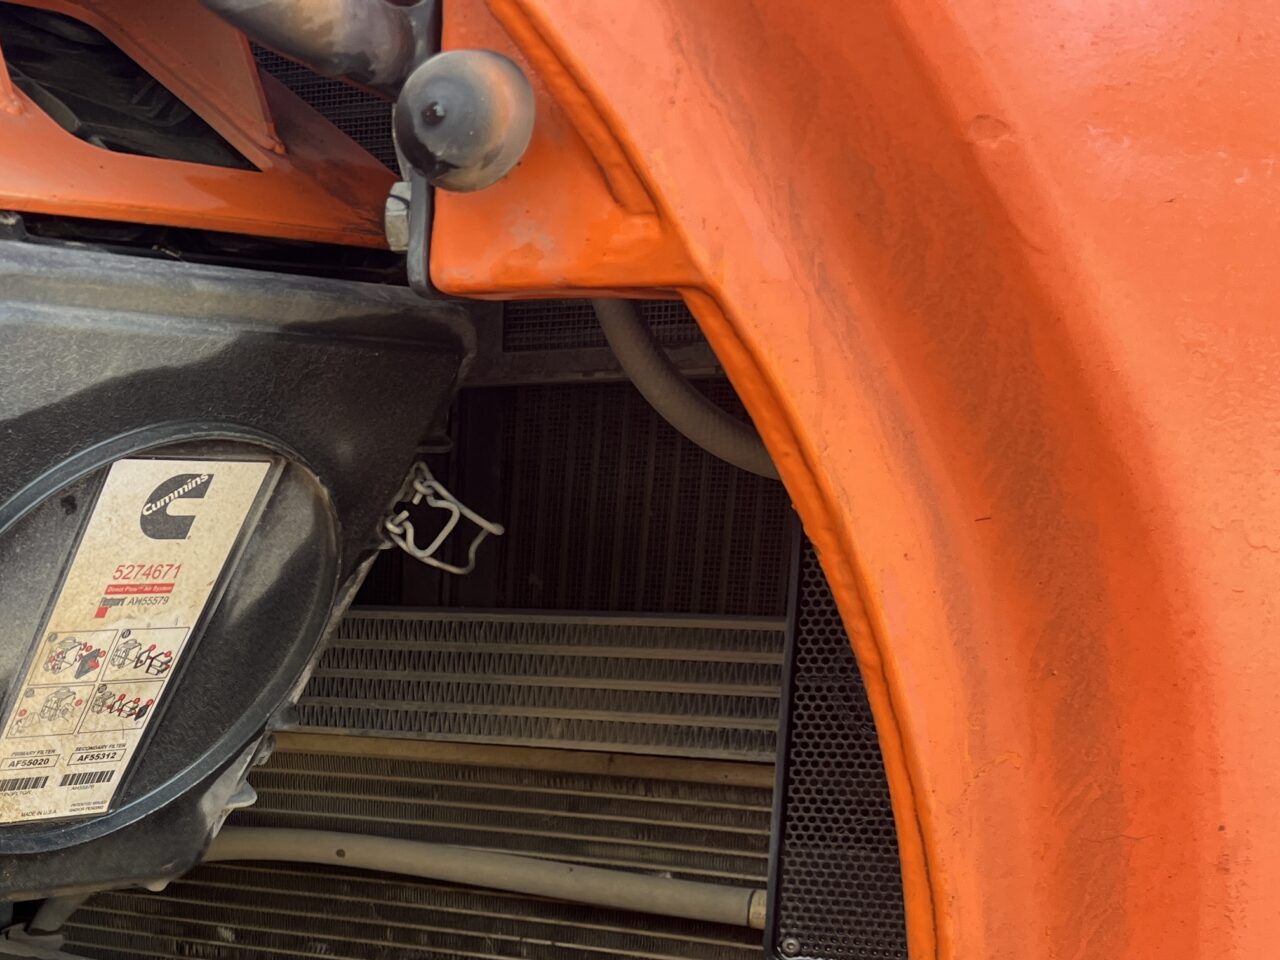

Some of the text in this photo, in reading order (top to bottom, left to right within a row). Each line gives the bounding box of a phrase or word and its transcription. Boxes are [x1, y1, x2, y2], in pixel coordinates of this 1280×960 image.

[142, 473, 209, 516] Cummins
[112, 563, 182, 580] 5274671
[7, 758, 50, 768] AF55020
[76, 751, 117, 762] AF55312
